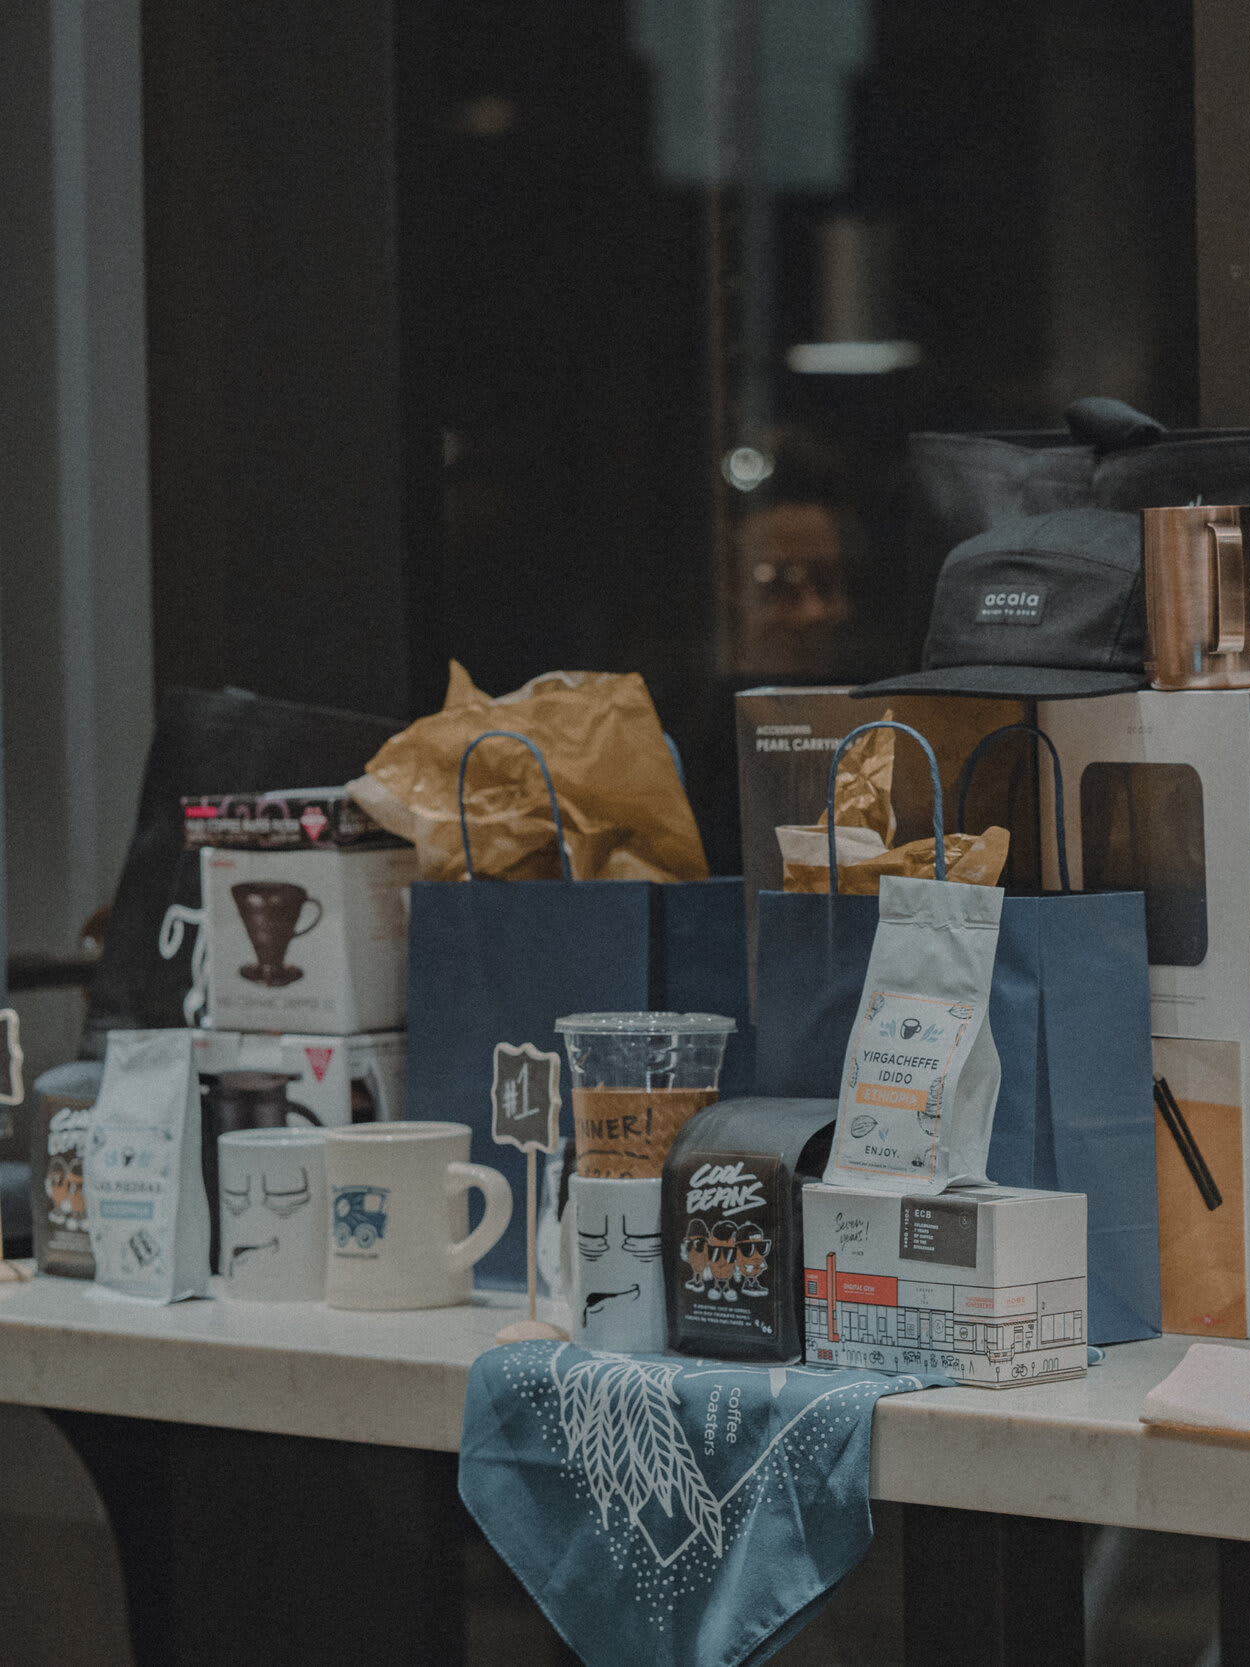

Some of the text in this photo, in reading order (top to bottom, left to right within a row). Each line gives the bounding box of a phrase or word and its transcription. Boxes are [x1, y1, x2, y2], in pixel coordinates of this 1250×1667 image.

[756, 738, 790, 751] PEARL
[792, 738, 853, 751] CARRYIG
[863, 1051, 939, 1070] YIRGACHEFFE
[879, 1070, 912, 1084] IDIDO
[502, 1063, 540, 1120] #1
[864, 1089, 918, 1105] ETHIOPIA
[865, 1145, 900, 1158] ENJOY.
[689, 1161, 757, 1188] COOL
[686, 1181, 767, 1216] BEANS
[835, 1212, 864, 1233] Seven
[915, 1209, 932, 1219] ECB
[705, 1384, 724, 1457] roasters
[726, 1387, 742, 1444] coffee
